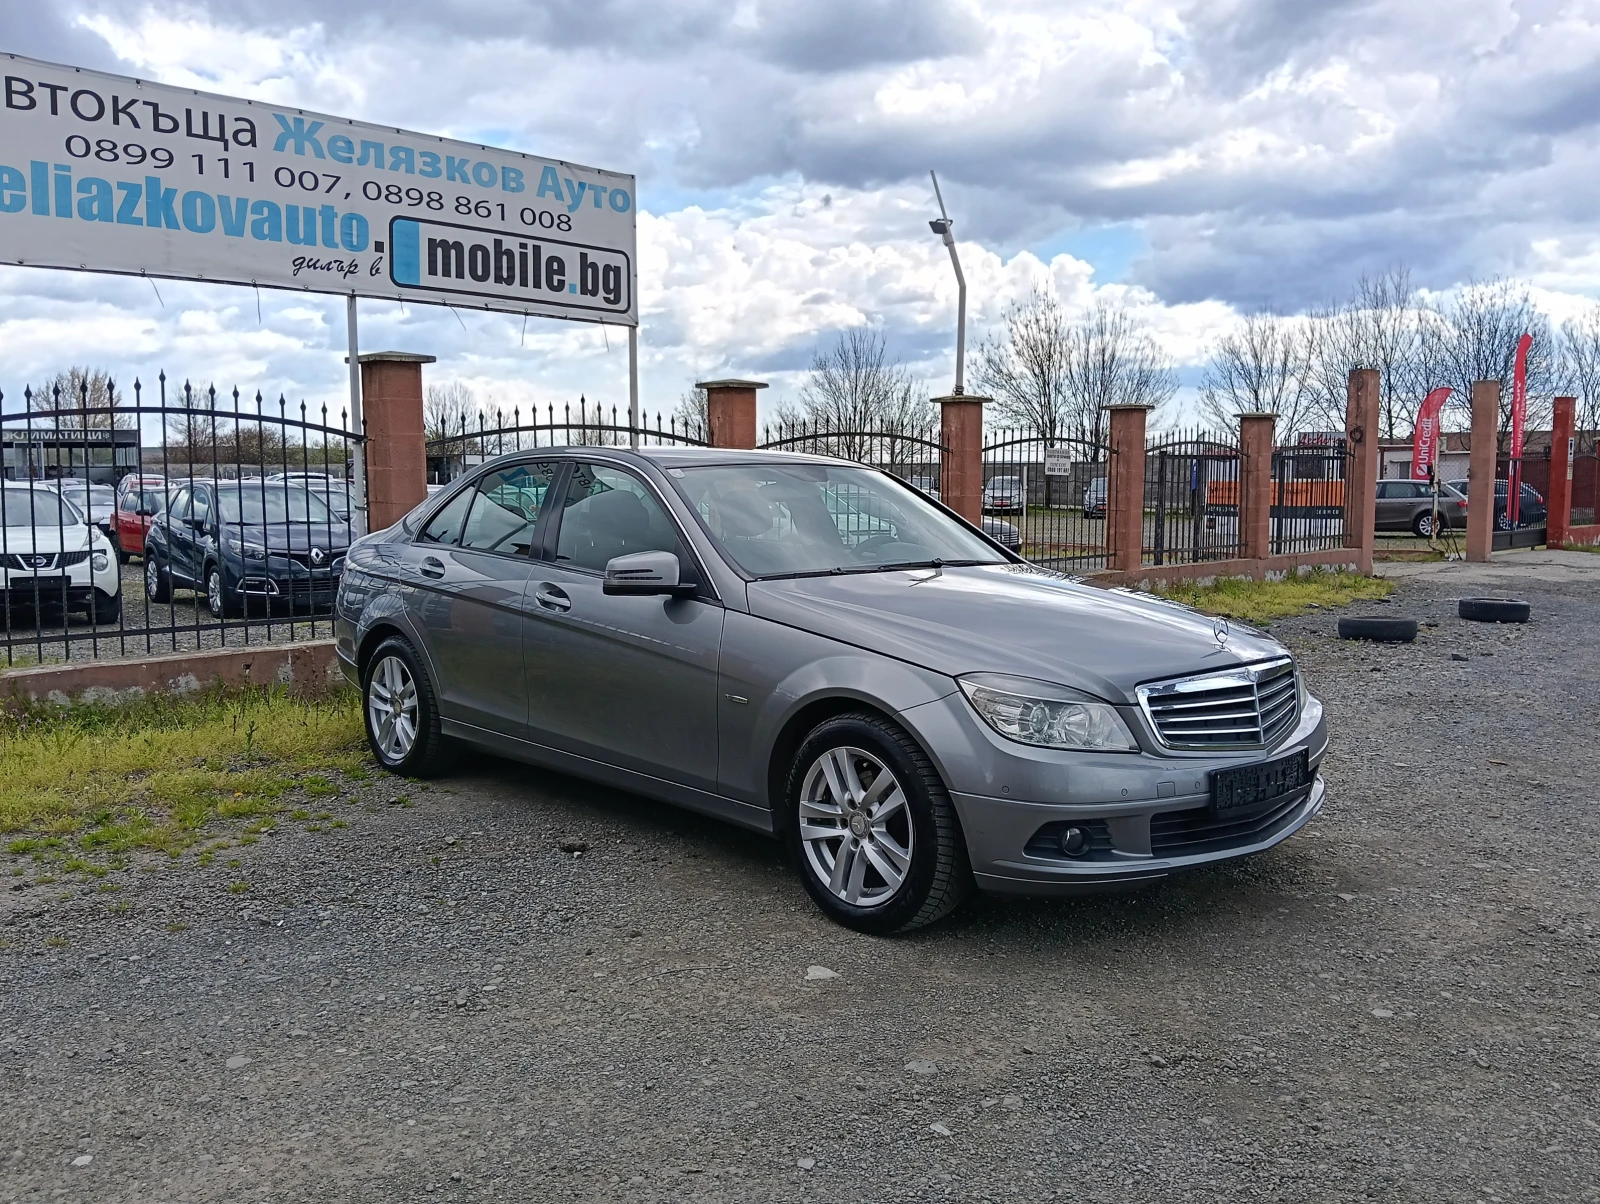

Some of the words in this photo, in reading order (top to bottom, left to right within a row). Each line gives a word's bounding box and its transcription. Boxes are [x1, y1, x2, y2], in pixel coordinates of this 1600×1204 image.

[65, 134, 175, 168] 0899
[191, 153, 255, 183] 111
[273, 166, 351, 200] 007,
[362, 180, 445, 211] 0898
[454, 196, 506, 222] 861
[519, 207, 573, 232] 008
[272, 113, 525, 193] Желязков
[536, 165, 631, 213] Ауто
[291, 256, 360, 280] дилър
[369, 255, 384, 277] в
[427, 237, 622, 305] mobile.bg
[1417, 418, 1433, 463] UniCredit
